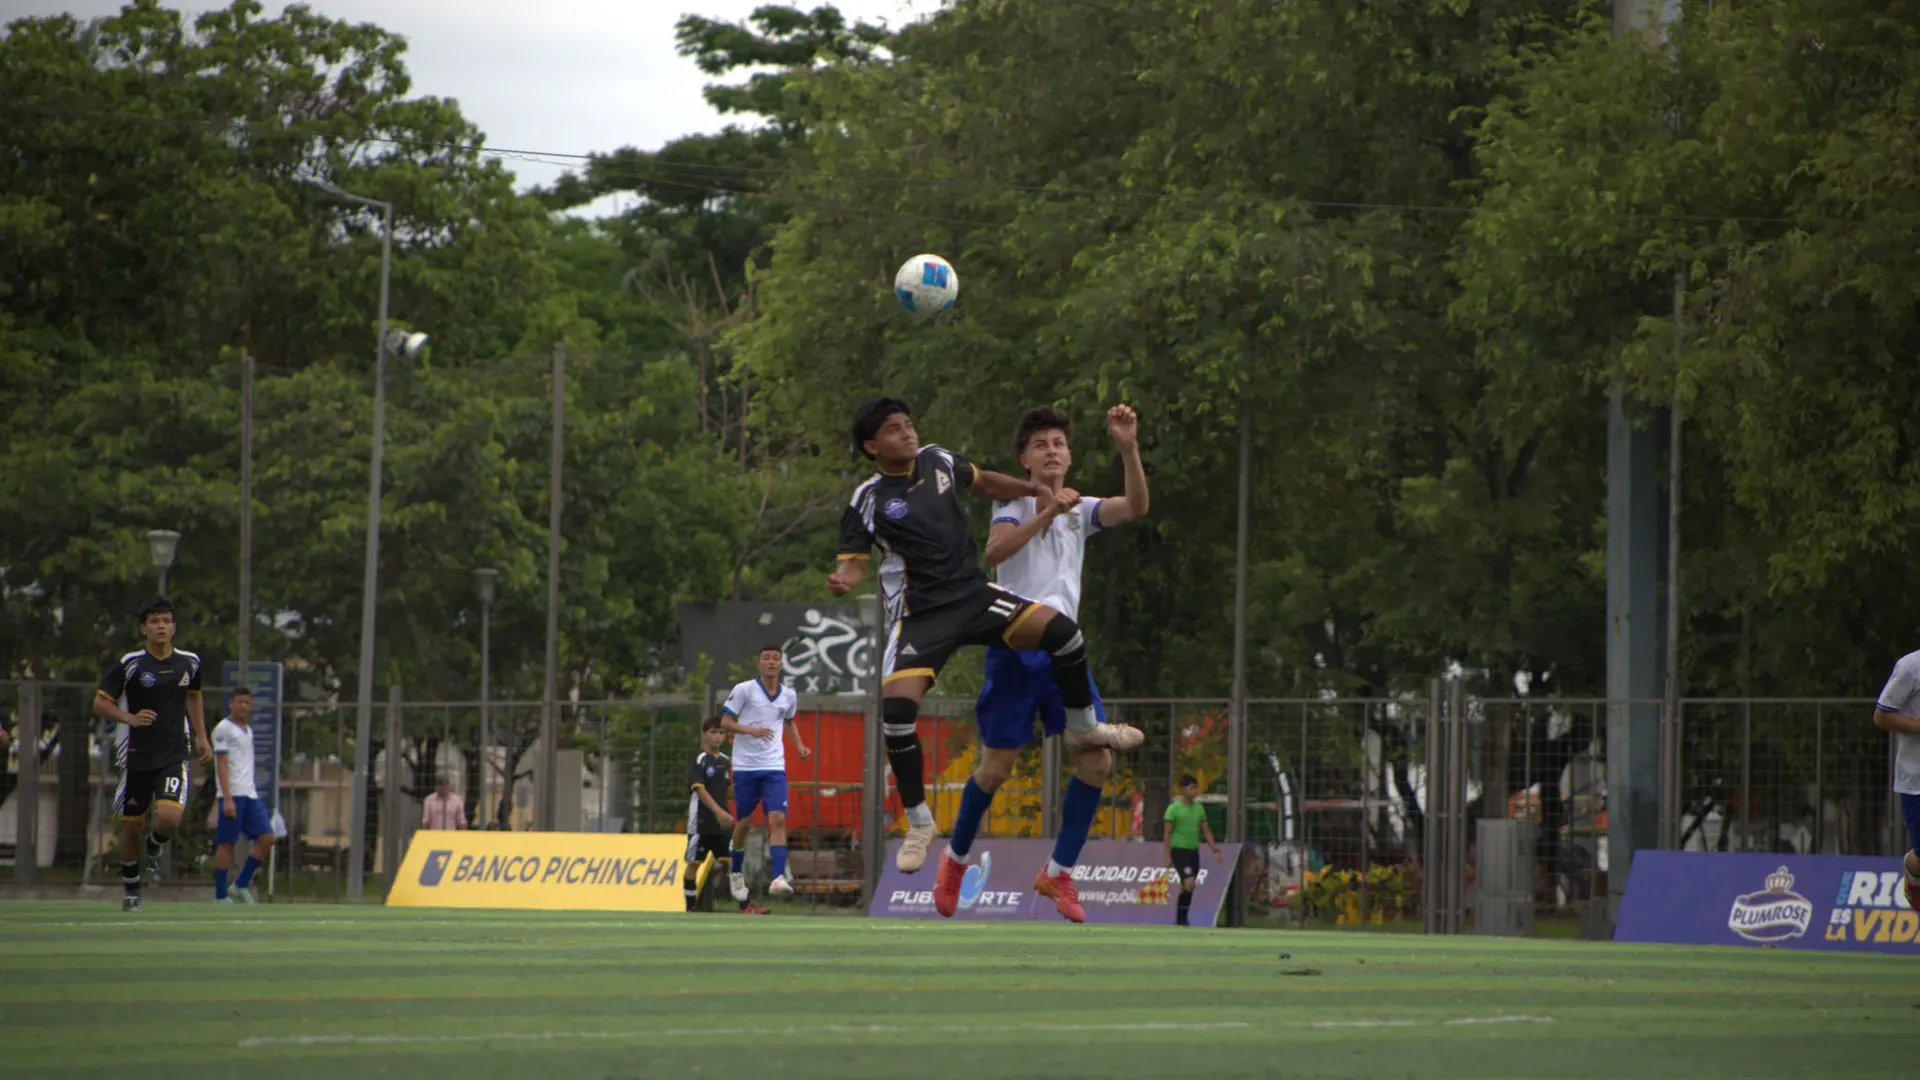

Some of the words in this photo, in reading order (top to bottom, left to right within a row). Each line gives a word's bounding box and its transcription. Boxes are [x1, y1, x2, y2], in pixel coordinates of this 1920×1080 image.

[987, 598, 1017, 618] 11
[164, 776, 180, 793] 19
[453, 854, 540, 883] BANCO
[541, 855, 679, 886] PICHINCHA
[1733, 903, 1809, 926] PLUMROSE
[1830, 908, 1852, 925] ES
[1825, 925, 1847, 941] LA
